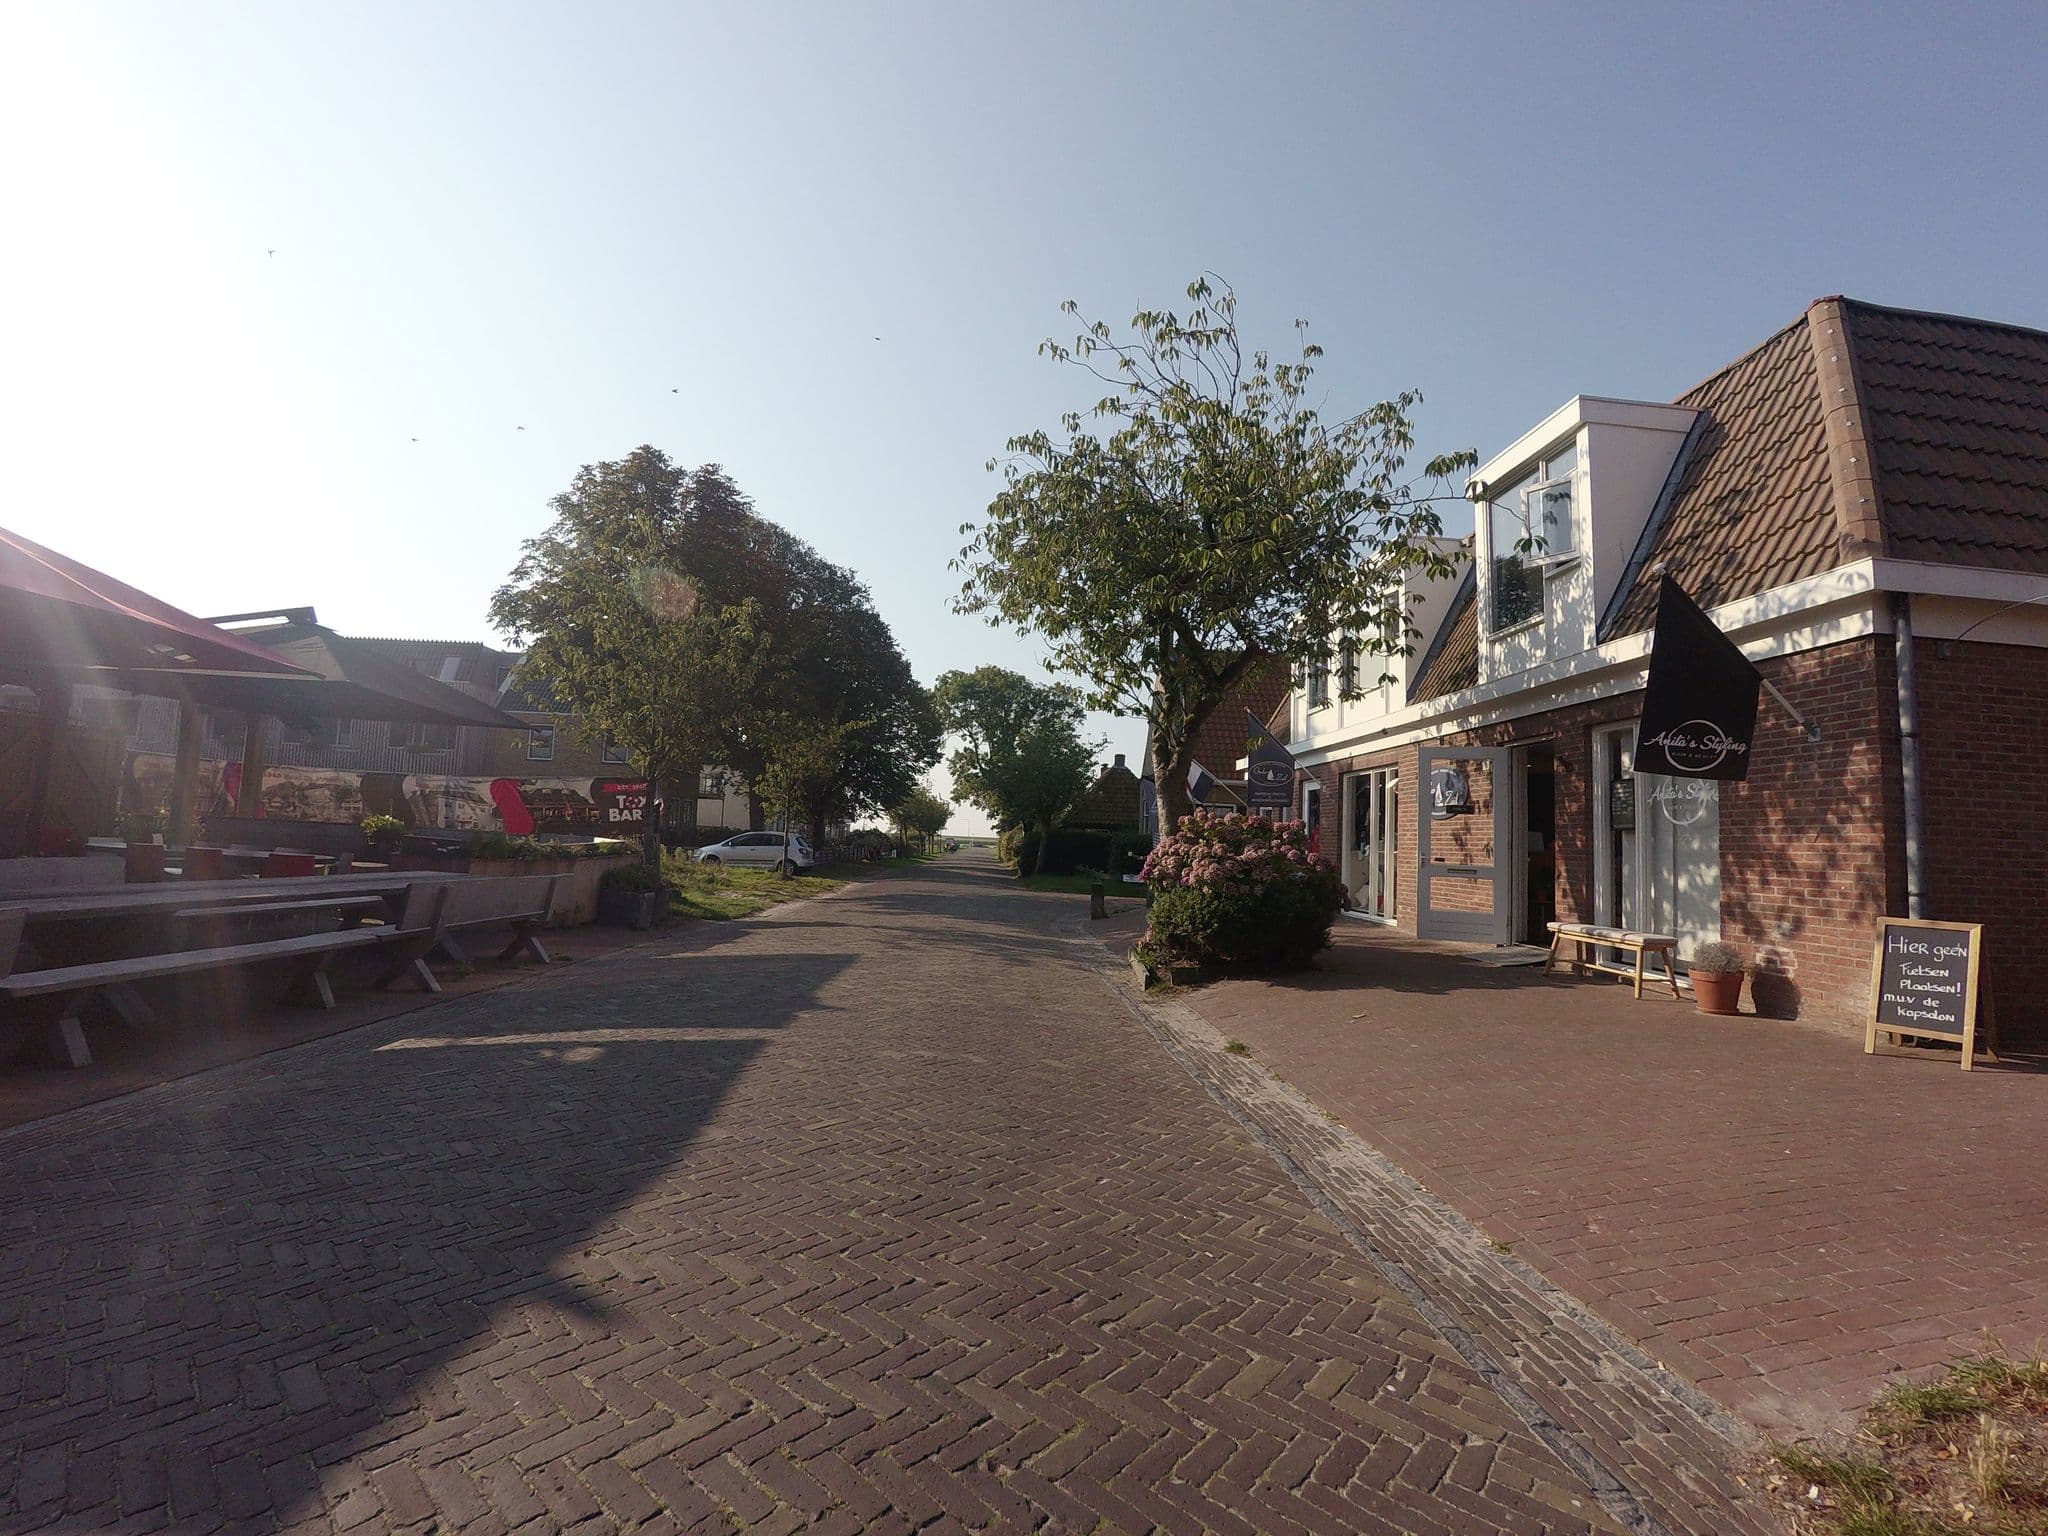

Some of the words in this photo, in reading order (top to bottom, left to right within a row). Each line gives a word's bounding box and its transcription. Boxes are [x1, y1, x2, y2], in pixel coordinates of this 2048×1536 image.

[1643, 731, 1697, 748] Anita's
[1699, 735, 1747, 755] Styling
[609, 808, 643, 822] BAR
[1922, 997, 1940, 1007] de
